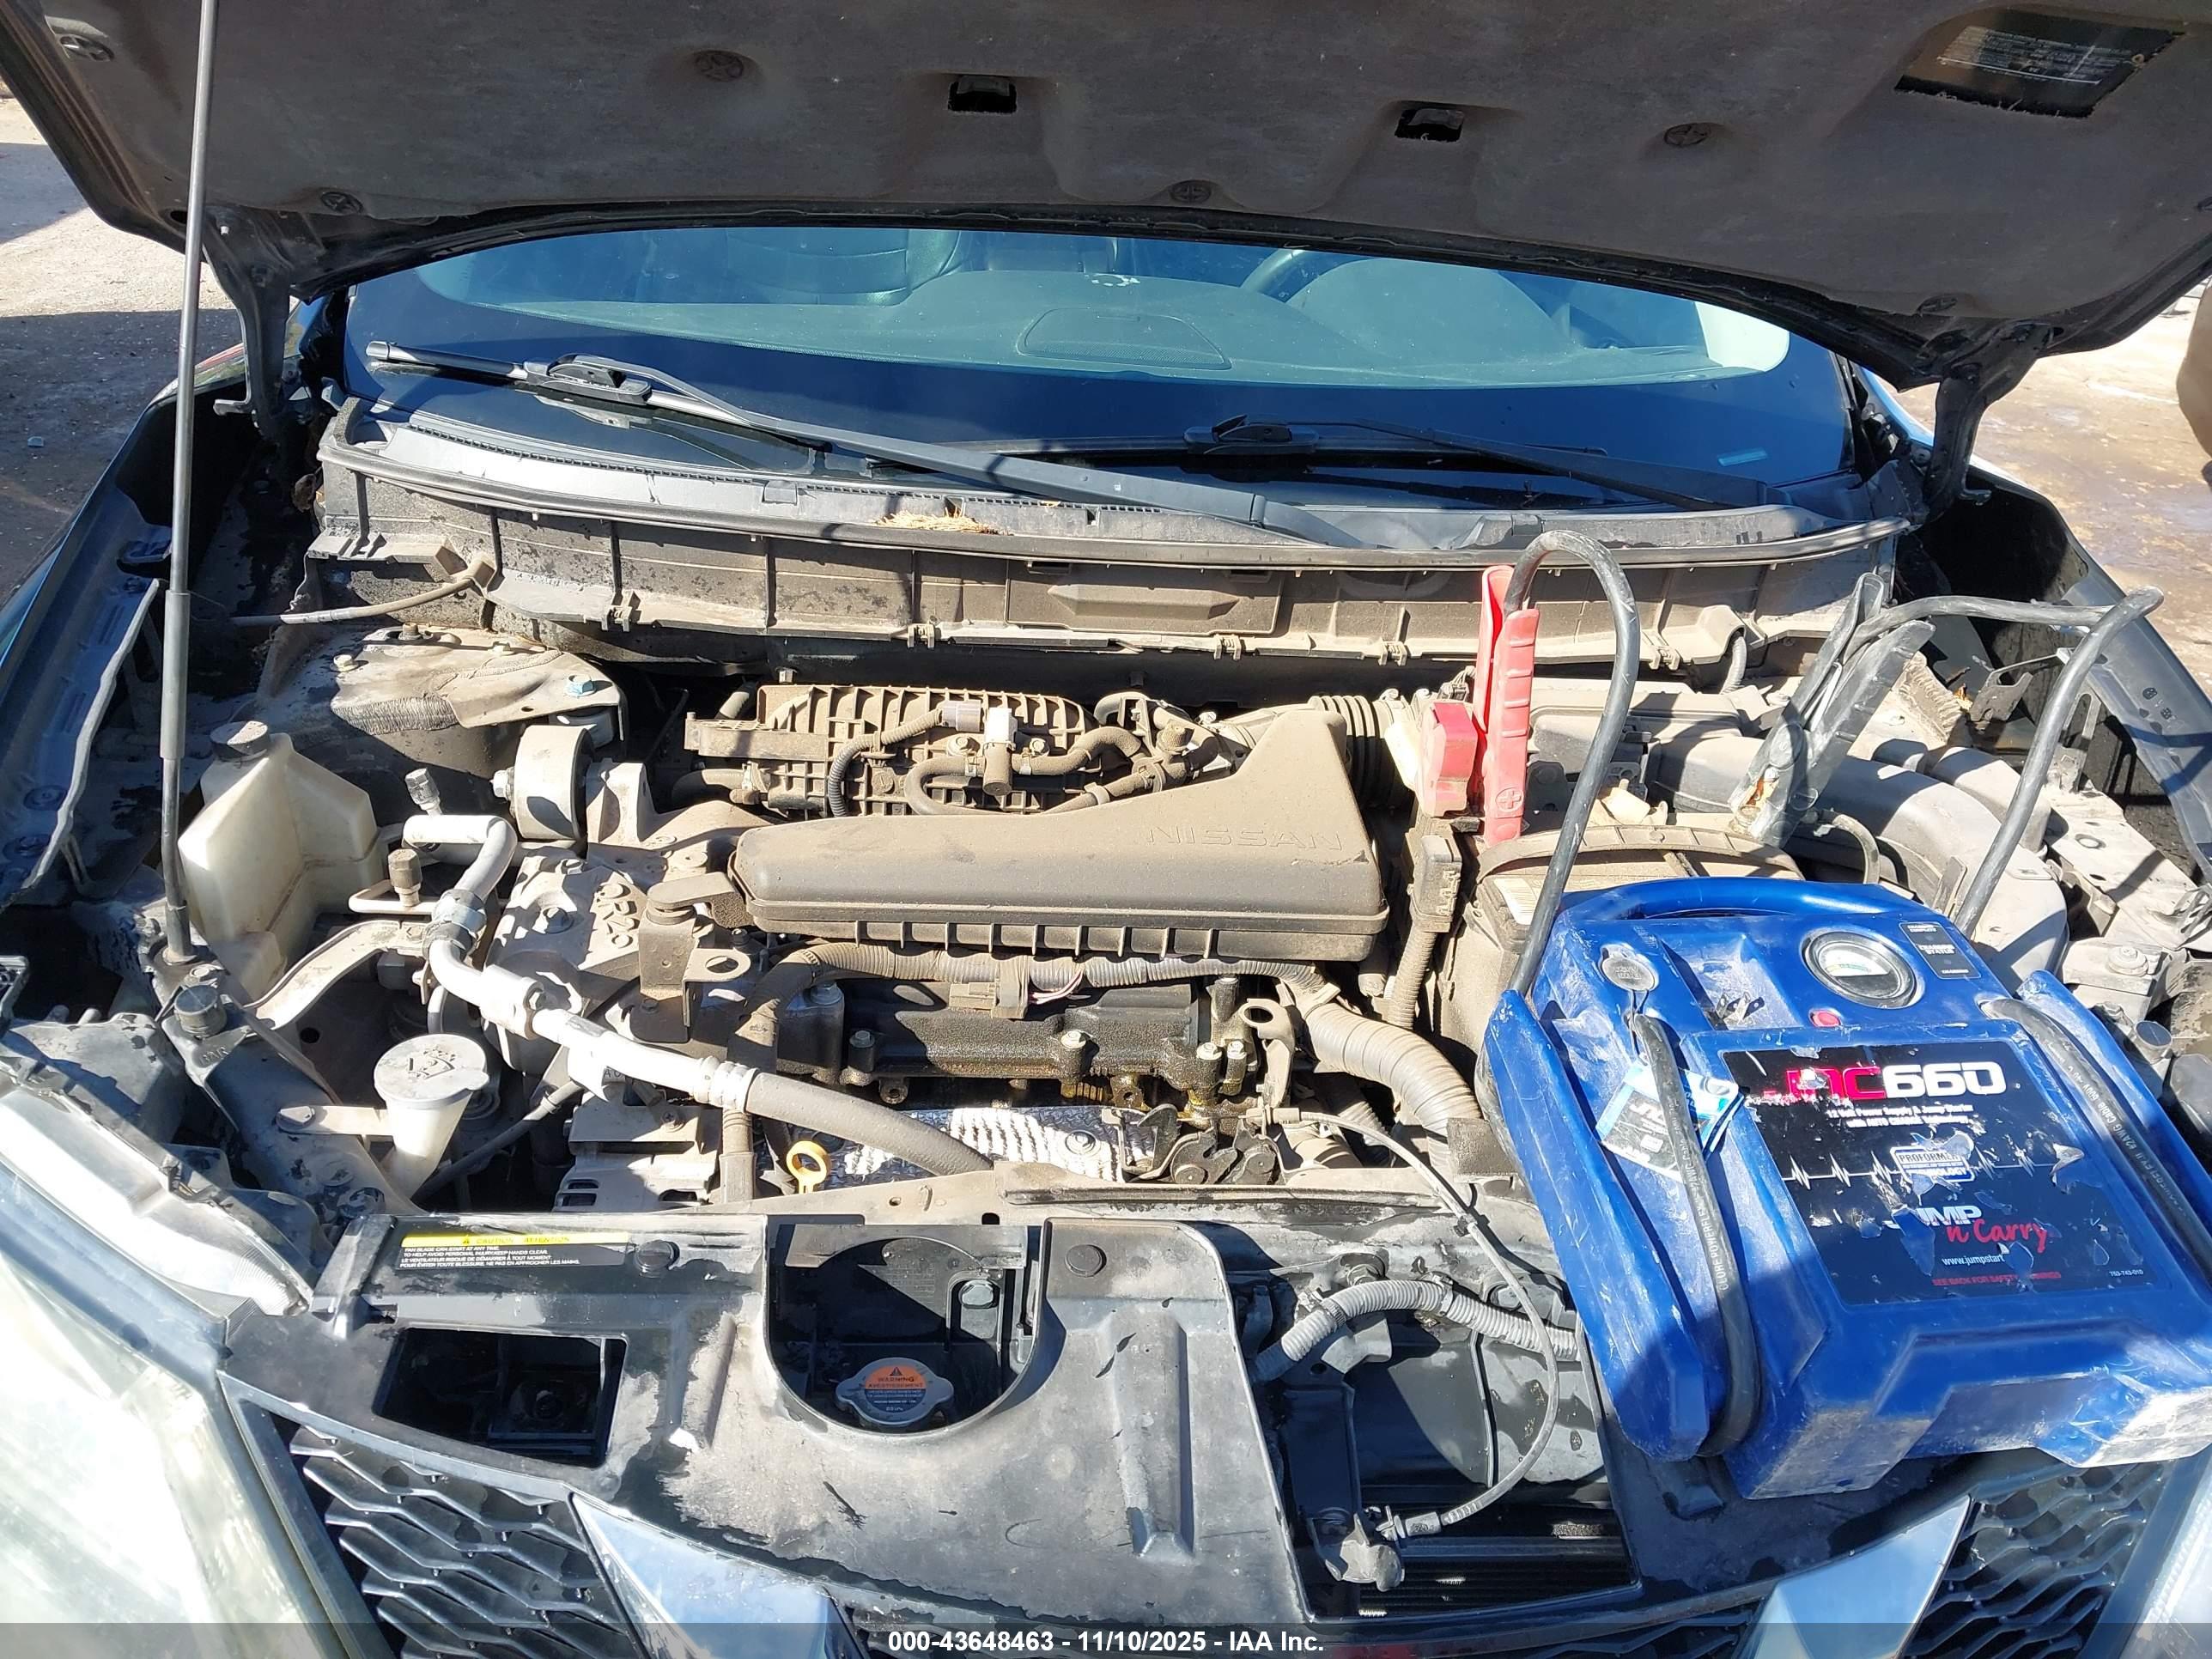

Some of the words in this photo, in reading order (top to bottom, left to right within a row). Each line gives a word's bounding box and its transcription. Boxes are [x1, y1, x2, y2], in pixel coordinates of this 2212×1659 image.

[1147, 825, 1343, 852] NISSAN
[2098, 1102, 2118, 1124] Cable
[1972, 1218, 2048, 1254] Carry
[1942, 1253, 2007, 1267] www.jumpstart
[1972, 1275, 1990, 1284] FOR
